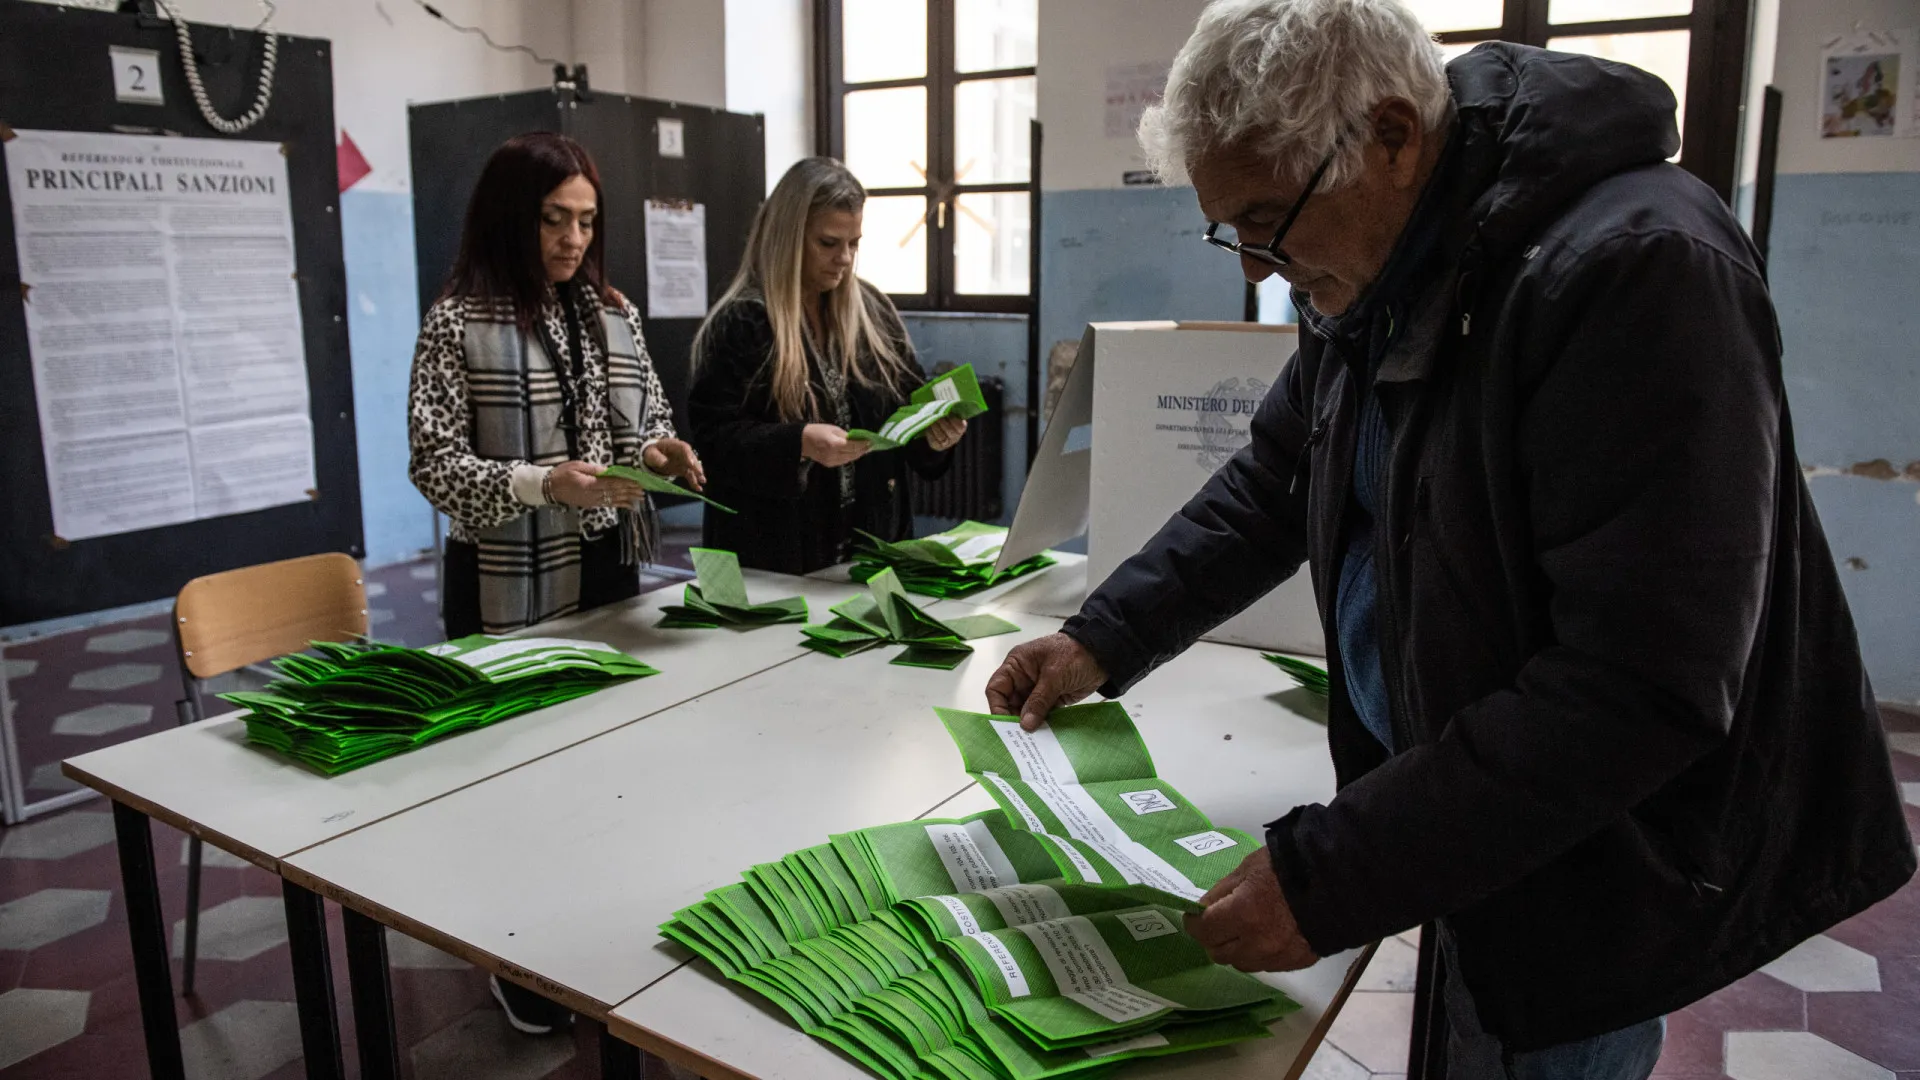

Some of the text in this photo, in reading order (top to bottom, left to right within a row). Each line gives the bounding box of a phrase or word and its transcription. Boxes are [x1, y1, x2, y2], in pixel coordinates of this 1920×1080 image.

[127, 65, 145, 91] 2
[61, 152, 145, 165] REFERENDUM
[26, 168, 276, 195] PRINCIPALI SANZIONI
[1157, 395, 1228, 412] MINISTERO
[1130, 793, 1168, 812] NO
[1185, 834, 1225, 851] SI
[1127, 914, 1165, 932] SI
